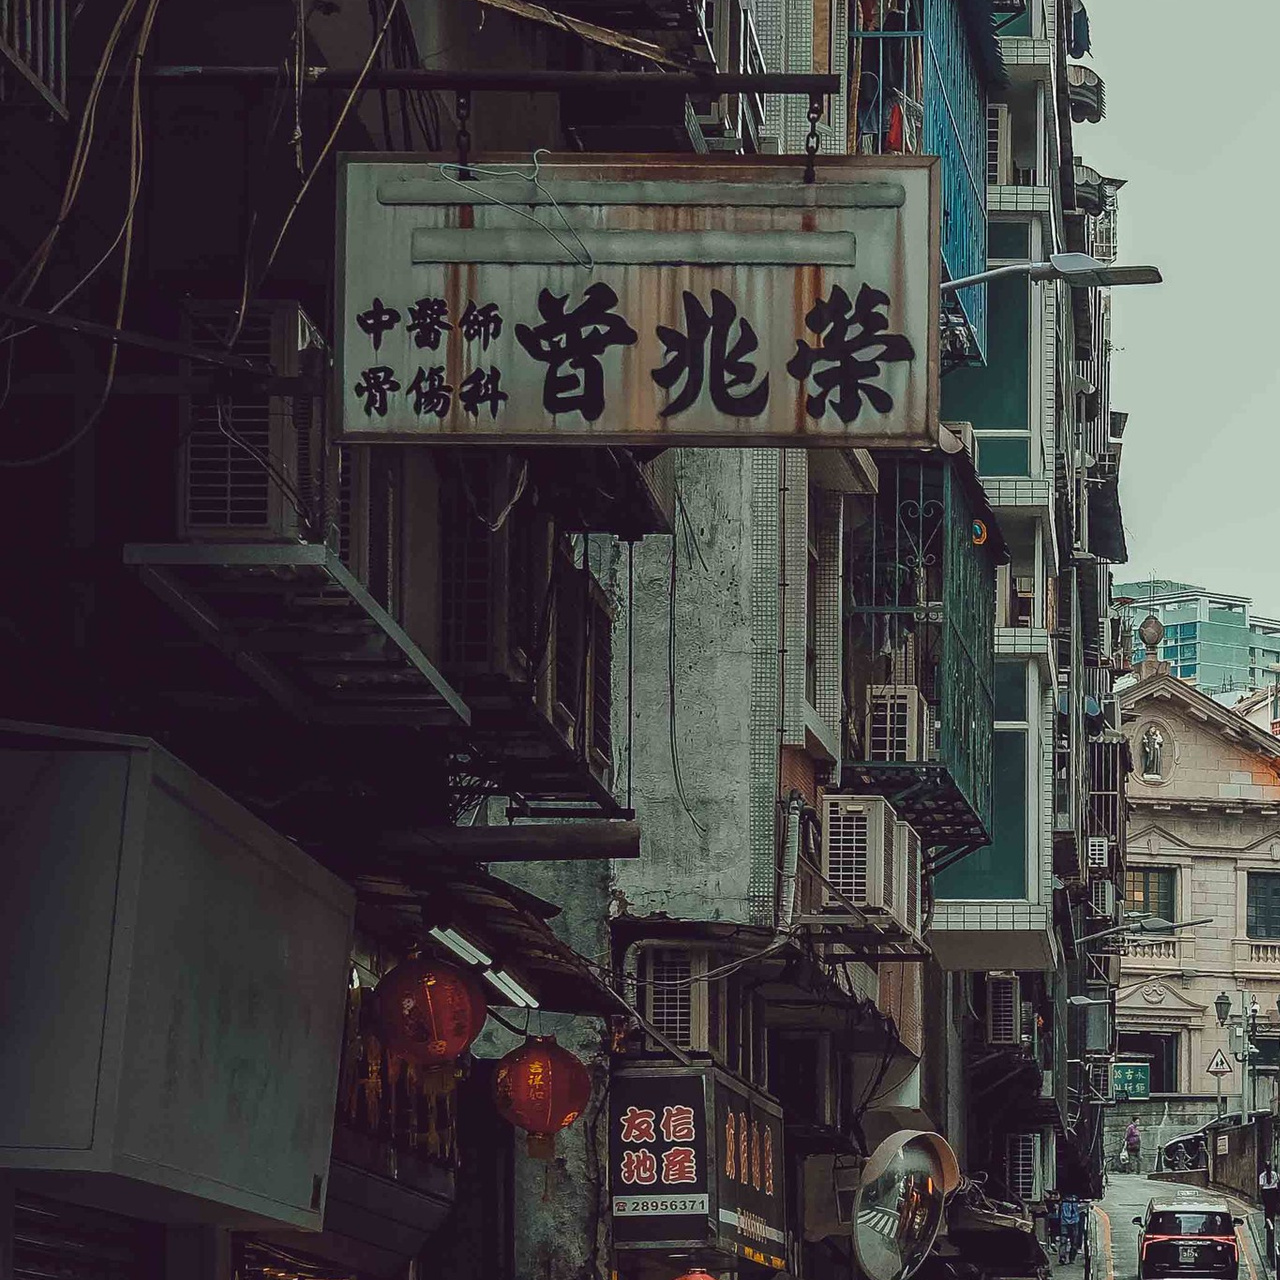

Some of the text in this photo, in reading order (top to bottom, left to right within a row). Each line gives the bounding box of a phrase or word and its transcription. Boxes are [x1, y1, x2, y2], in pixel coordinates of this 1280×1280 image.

[355, 297, 503, 351] 中醫師
[514, 282, 917, 423] 曾兆榮
[354, 365, 509, 420] 骨傷科
[620, 1105, 696, 1143] 友信
[631, 1200, 706, 1212] 28956371
